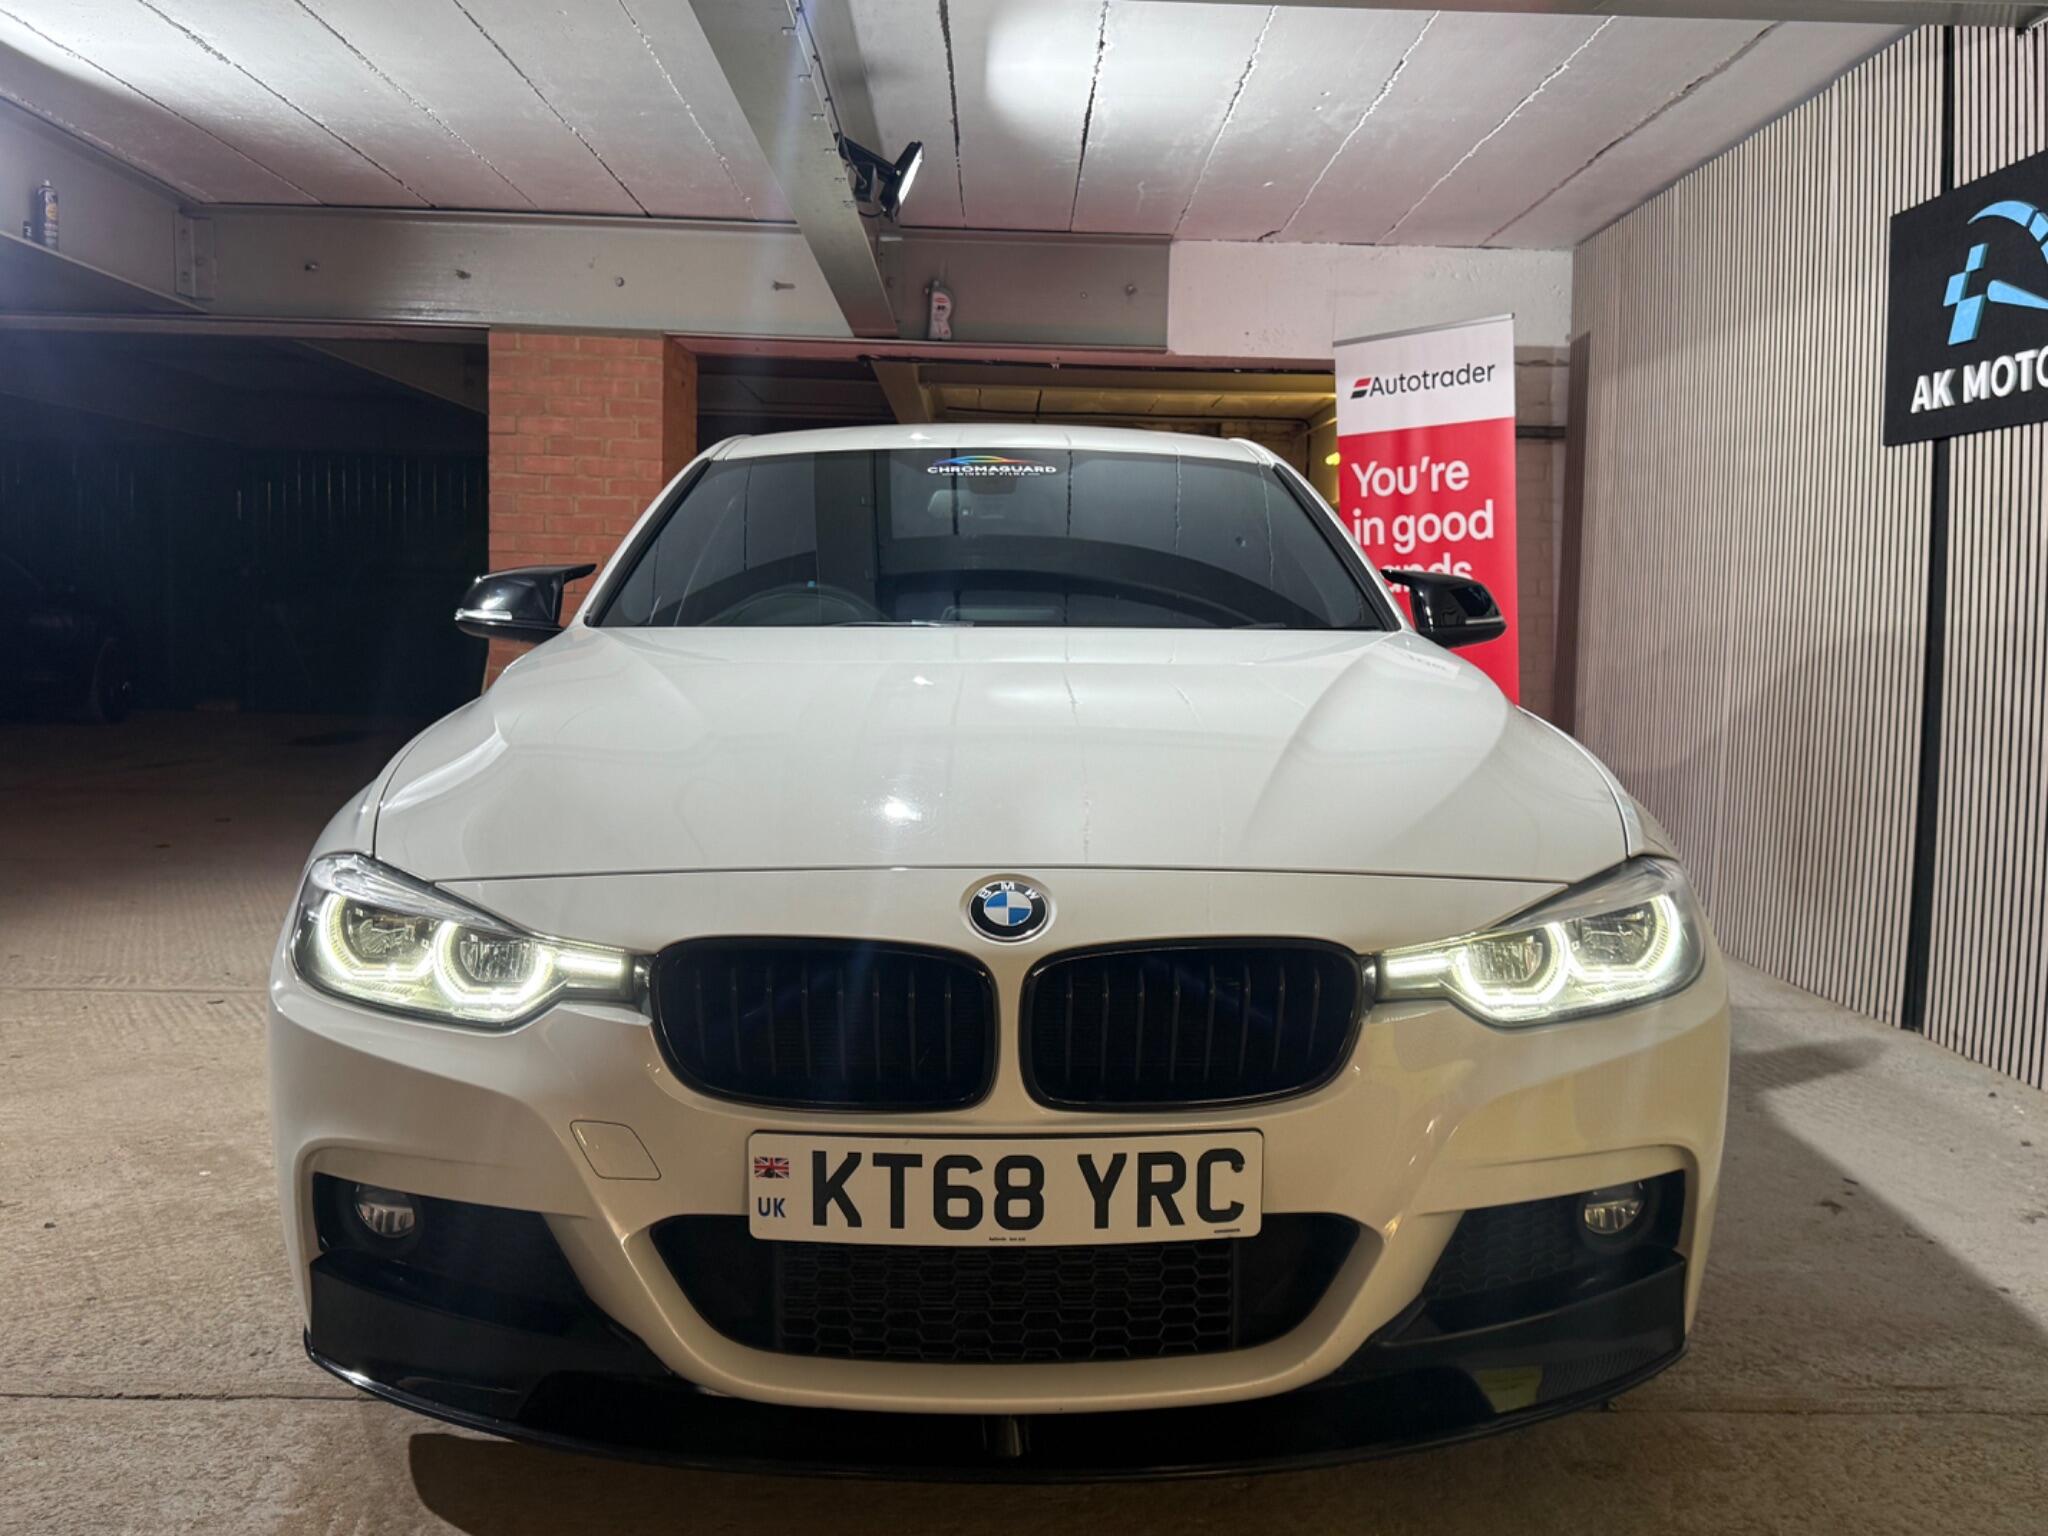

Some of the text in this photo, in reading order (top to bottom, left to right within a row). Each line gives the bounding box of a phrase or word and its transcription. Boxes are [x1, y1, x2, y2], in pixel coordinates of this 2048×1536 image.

[1369, 363, 1496, 397] Autotrader
[1910, 368, 1956, 413] AK
[927, 465, 1057, 474] CHROMAGUARD
[1351, 457, 1470, 499] You’re
[1353, 500, 1495, 555] in good
[977, 880, 1041, 900] BMW
[757, 1197, 787, 1219] UK
[811, 1147, 1246, 1231] KT68 YRC
